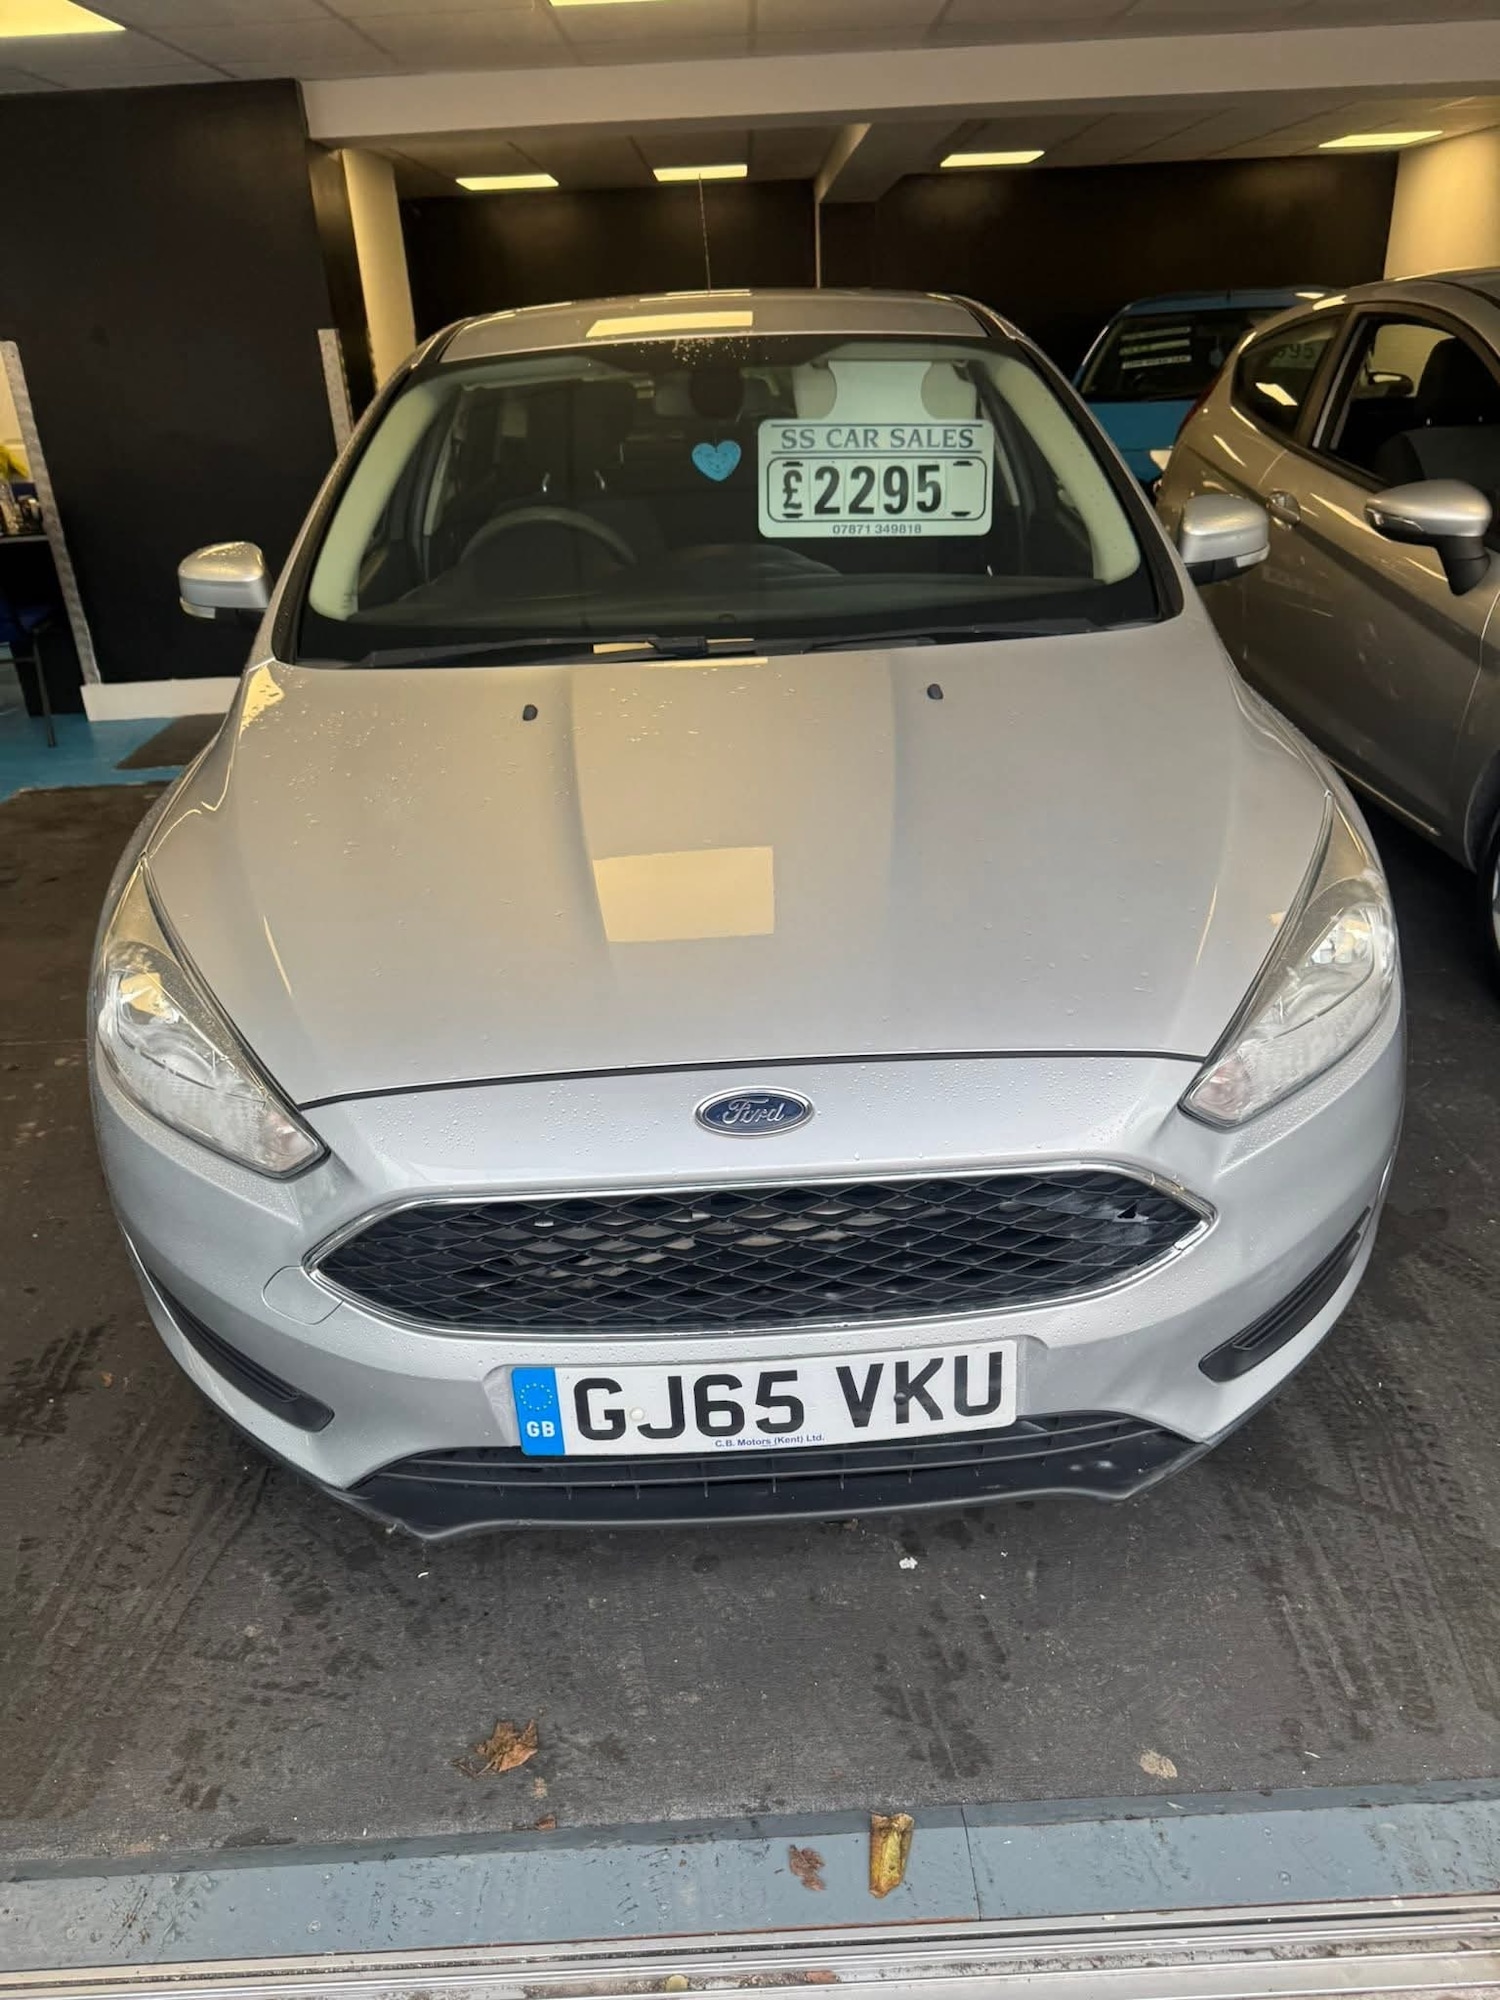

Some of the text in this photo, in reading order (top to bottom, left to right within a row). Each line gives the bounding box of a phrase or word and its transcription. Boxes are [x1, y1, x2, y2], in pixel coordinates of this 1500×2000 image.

[781, 428, 973, 449] SS CAR SALES
[782, 465, 942, 515] £2295
[832, 524, 922, 535] 07871 349818
[722, 1098, 784, 1124] Ford
[573, 1351, 1003, 1441] GJ65 VKU
[526, 1421, 555, 1438] GB
[738, 1438, 771, 1446] Motors
[774, 1435, 803, 1445] (Kent)
[806, 1434, 825, 1442] Ltd.
